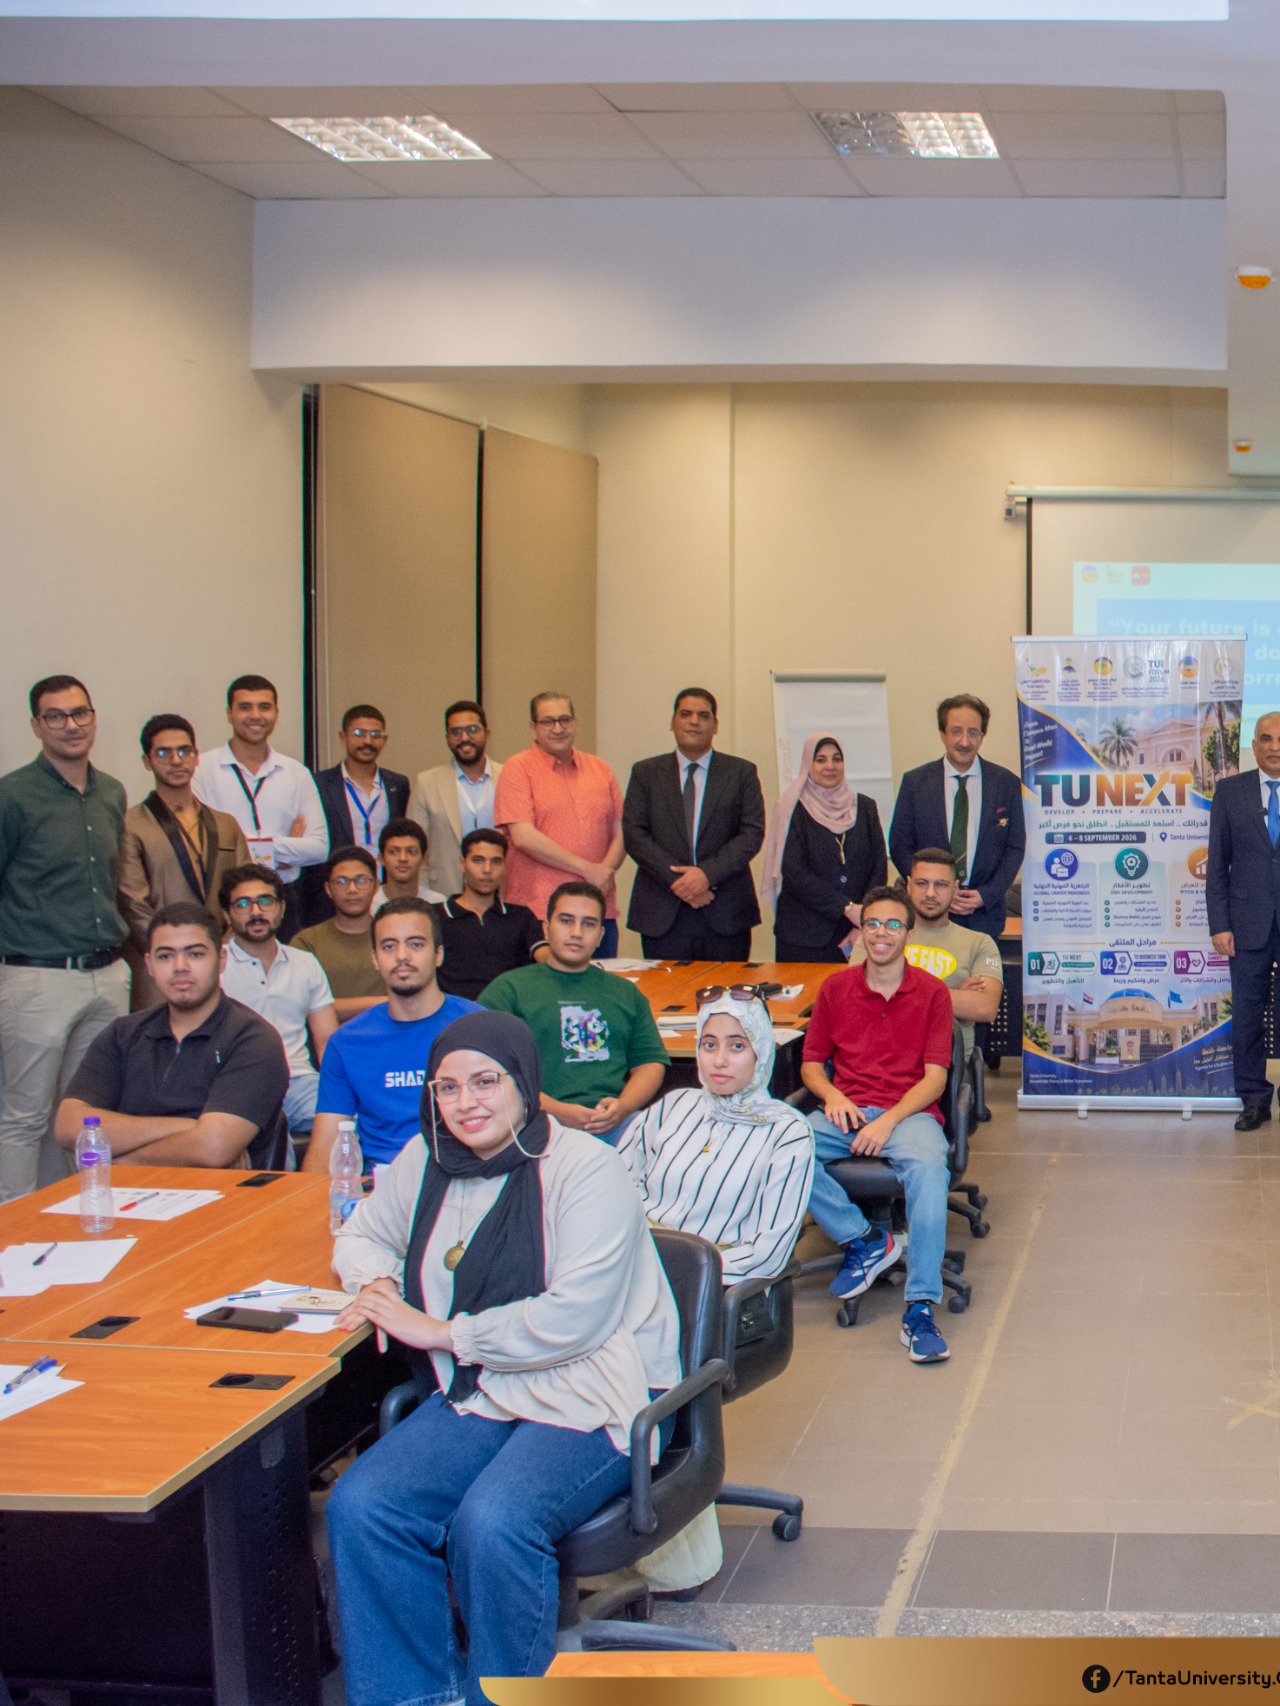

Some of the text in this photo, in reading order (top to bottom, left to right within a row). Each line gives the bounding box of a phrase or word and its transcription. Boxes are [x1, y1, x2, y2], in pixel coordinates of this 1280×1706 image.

[1110, 619, 1173, 634] "Your
[1178, 618, 1246, 635] future
[1252, 620, 1271, 636] is
[1038, 819, 1052, 830] أكبر
[1054, 821, 1071, 830] فرص
[1072, 821, 1085, 829] نحو
[1086, 820, 1108, 830] انطلق
[1115, 820, 1151, 829] للمستقبل
[1152, 820, 1175, 828] استعد
[1084, 834, 1120, 842] SEPTEMBER
[1112, 882, 1131, 890] الأفكار
[1109, 938, 1157, 947] مراحل الملتقى
[919, 948, 953, 976] FAST
[1030, 959, 1040, 970] 01
[1102, 958, 1113, 970] 02
[1176, 957, 1187, 969] 03
[1041, 977, 1084, 985] التأهيل والتطوير
